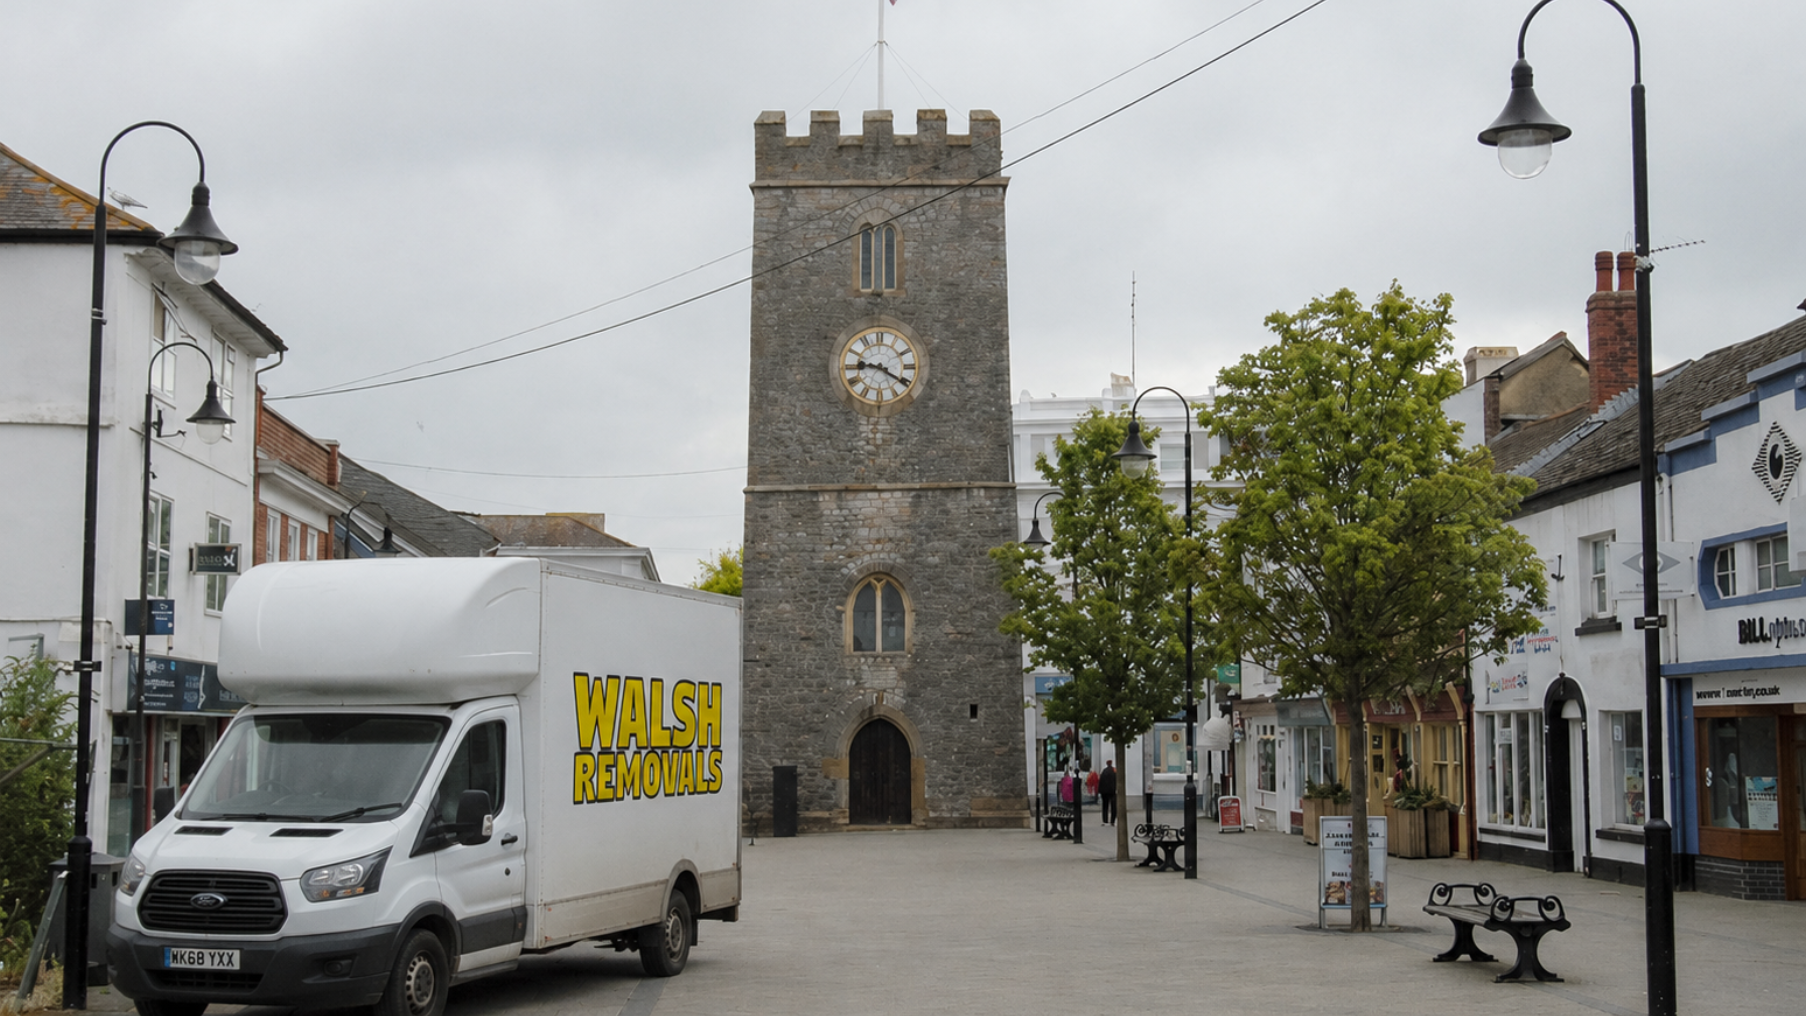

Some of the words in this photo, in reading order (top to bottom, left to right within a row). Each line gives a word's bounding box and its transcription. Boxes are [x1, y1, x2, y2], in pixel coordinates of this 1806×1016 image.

[573, 672, 722, 750] WALSH
[573, 749, 723, 805] REMOVALS
[208, 951, 234, 967] YXX
